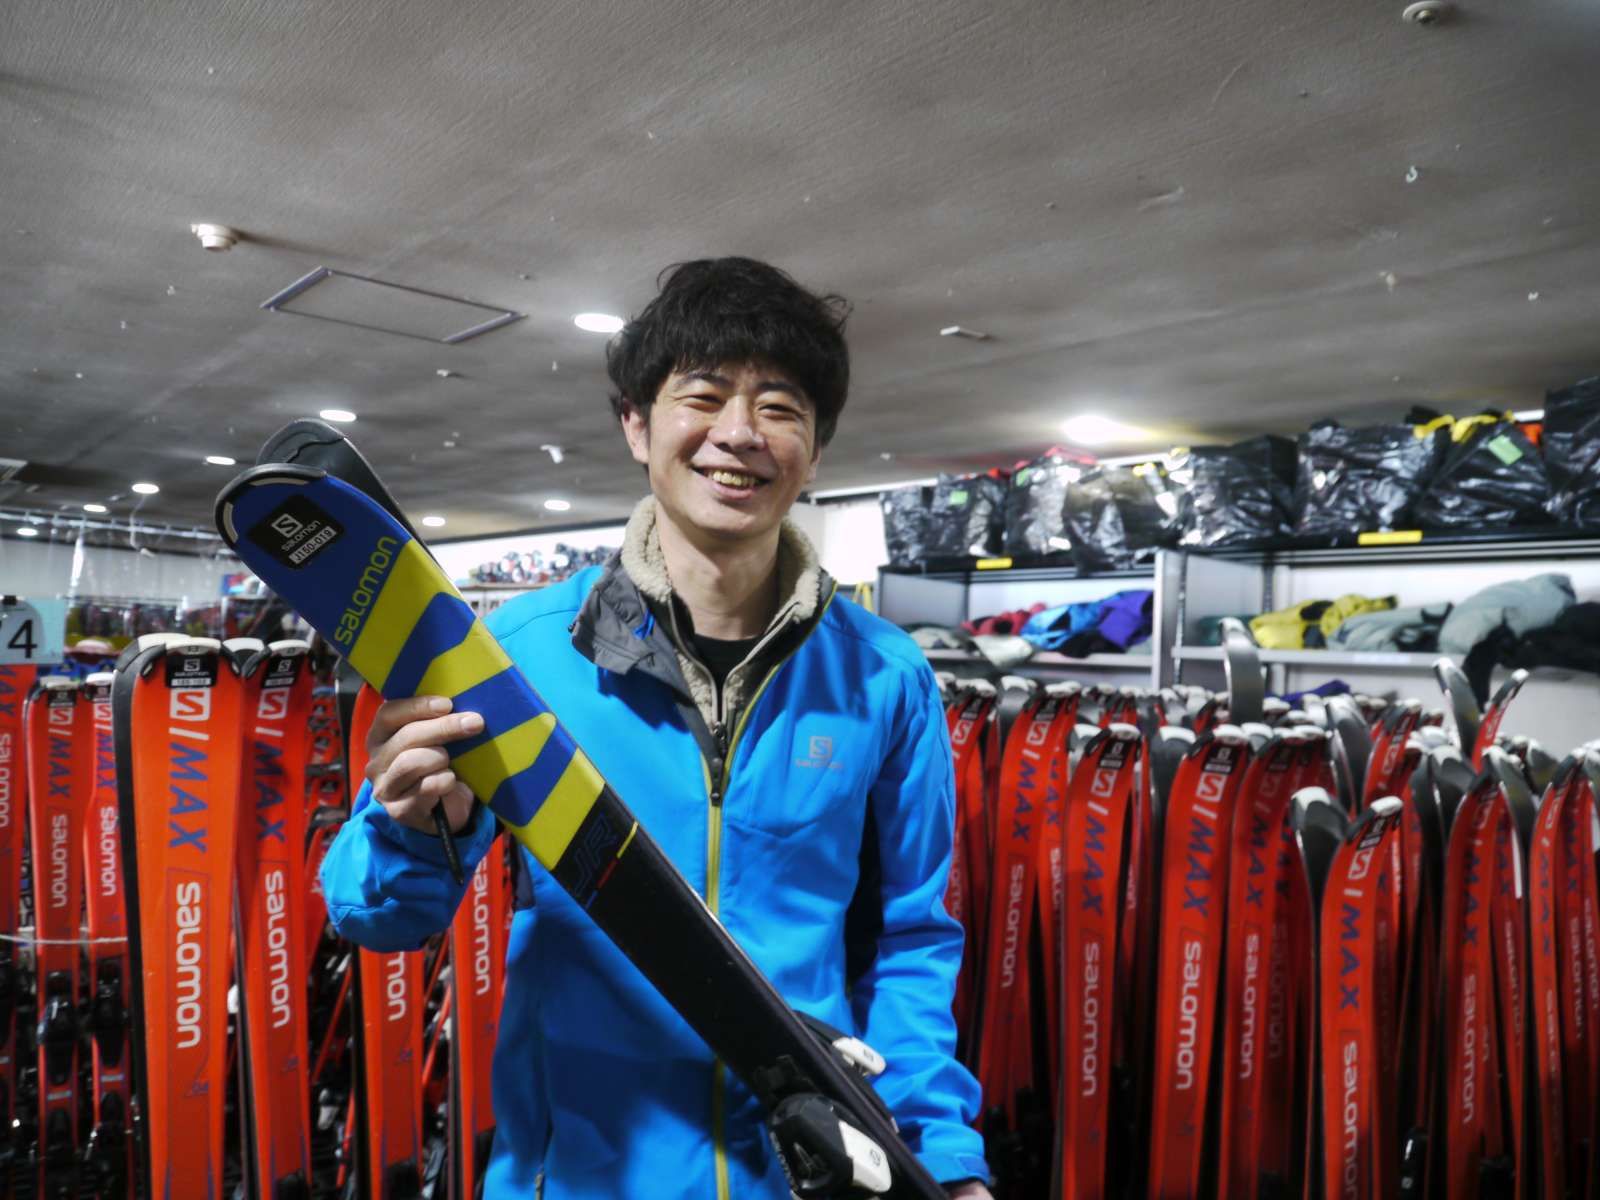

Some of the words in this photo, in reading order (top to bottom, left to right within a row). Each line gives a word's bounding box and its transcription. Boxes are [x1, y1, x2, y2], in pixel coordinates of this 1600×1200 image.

[0, 619, 38, 659] 4
[334, 536, 398, 645] salomon
[176, 881, 201, 1050] salomon
[264, 870, 291, 1028] salomon
[1002, 864, 1025, 989] salomon
[1083, 943, 1100, 1097] salomon
[1176, 941, 1201, 1091] salomon
[1241, 933, 1259, 1079] salomon
[1462, 974, 1477, 1125] salomon
